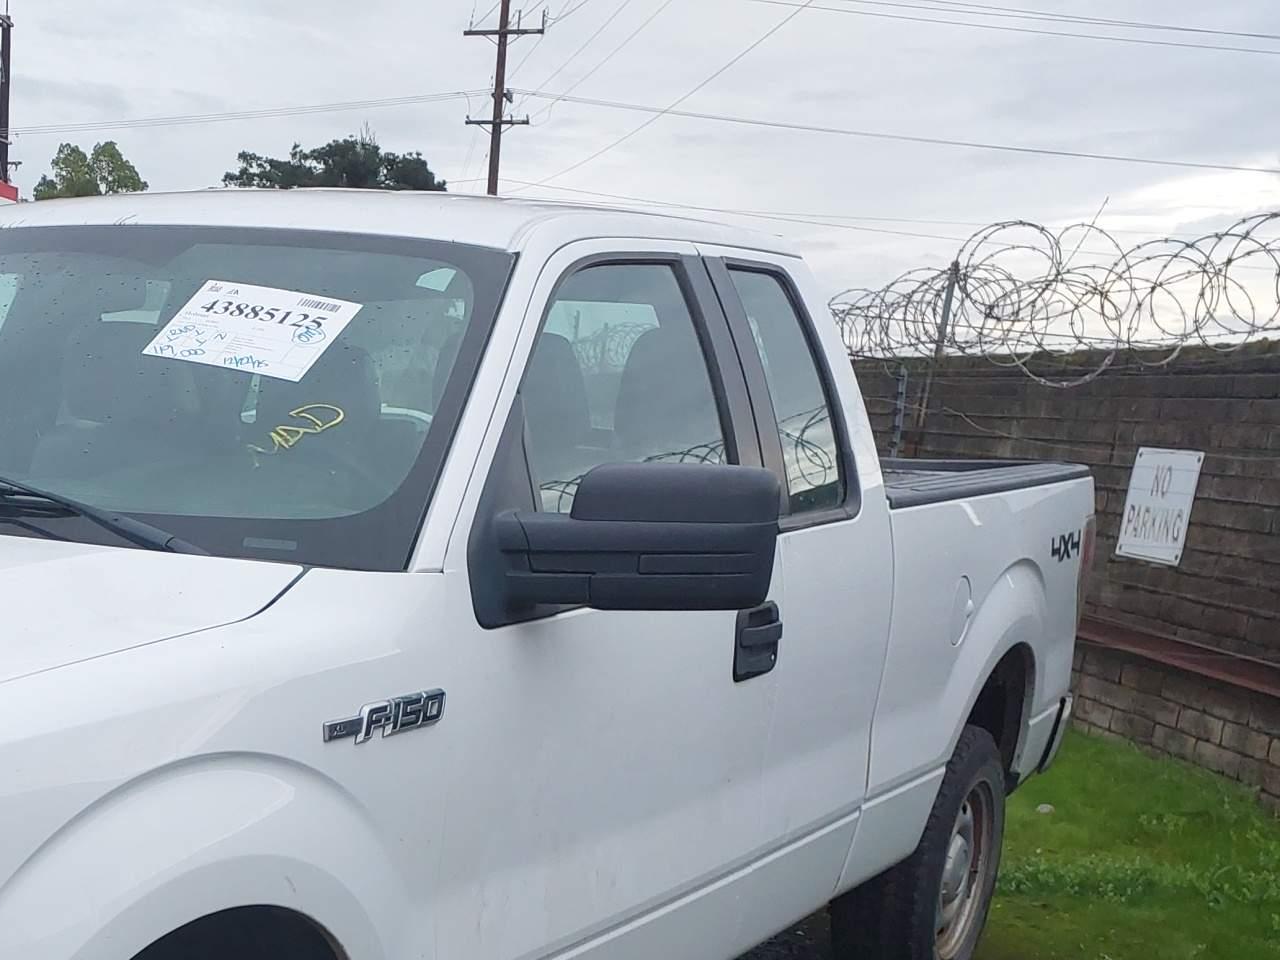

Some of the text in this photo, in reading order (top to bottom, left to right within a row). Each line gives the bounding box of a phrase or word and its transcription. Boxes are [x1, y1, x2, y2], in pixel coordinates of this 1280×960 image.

[201, 299, 329, 330] 43885125
[1150, 464, 1173, 498] NO
[1124, 504, 1184, 544] PARKING
